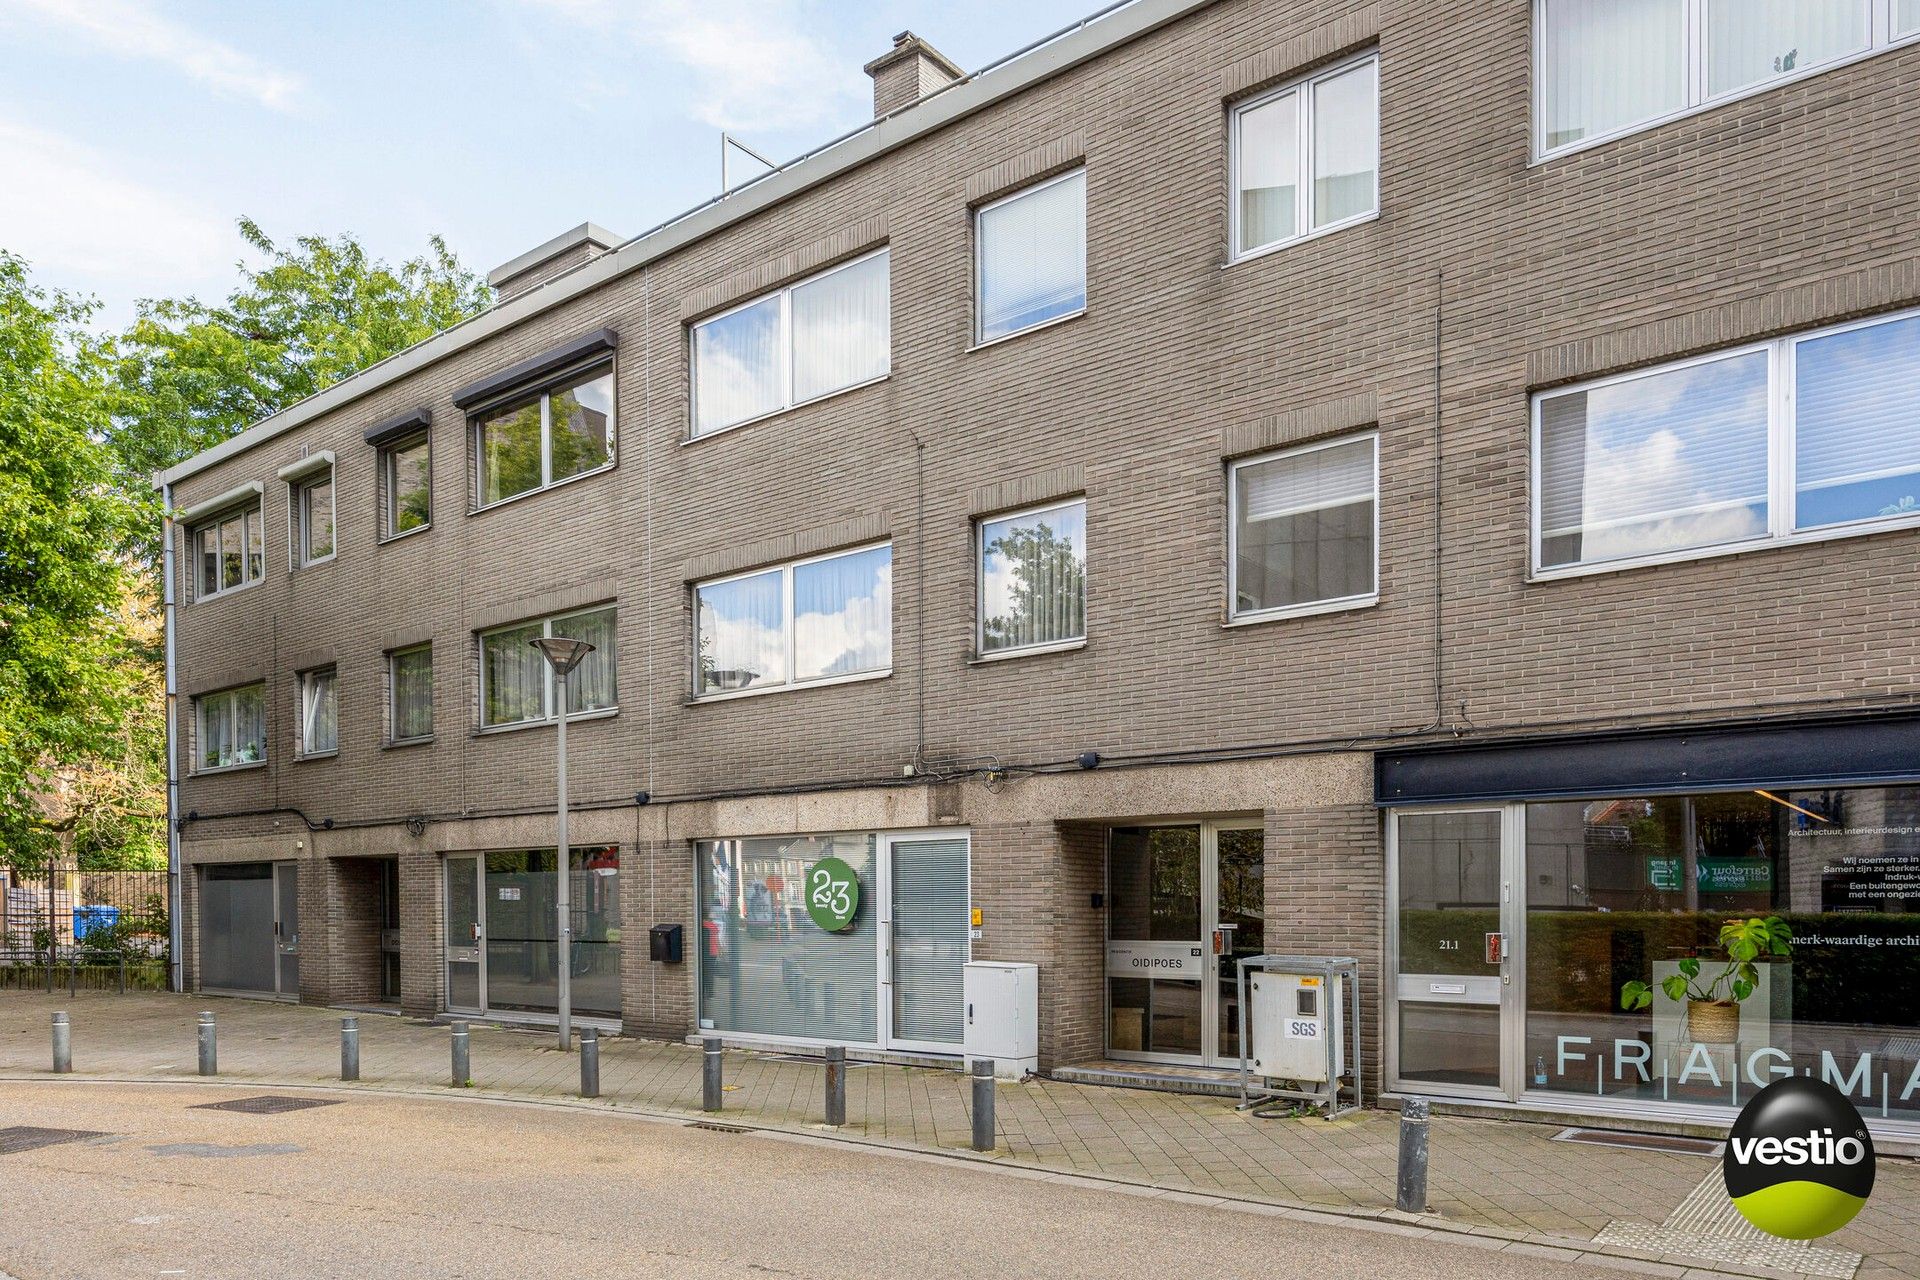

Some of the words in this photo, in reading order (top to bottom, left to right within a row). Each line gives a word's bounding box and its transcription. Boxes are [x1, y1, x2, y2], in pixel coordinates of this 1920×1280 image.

[1787, 828, 1843, 837] Architectuur,
[1844, 826, 1913, 836] interieurdesign
[1842, 856, 1857, 865] Wij
[1823, 865, 1855, 873] Samen
[1856, 865, 1872, 874] zijn
[1849, 882, 1867, 890] Een
[1439, 940, 1459, 950] 21.1
[1132, 958, 1183, 969] OIDIPOES
[1291, 1021, 1317, 1037] SGS
